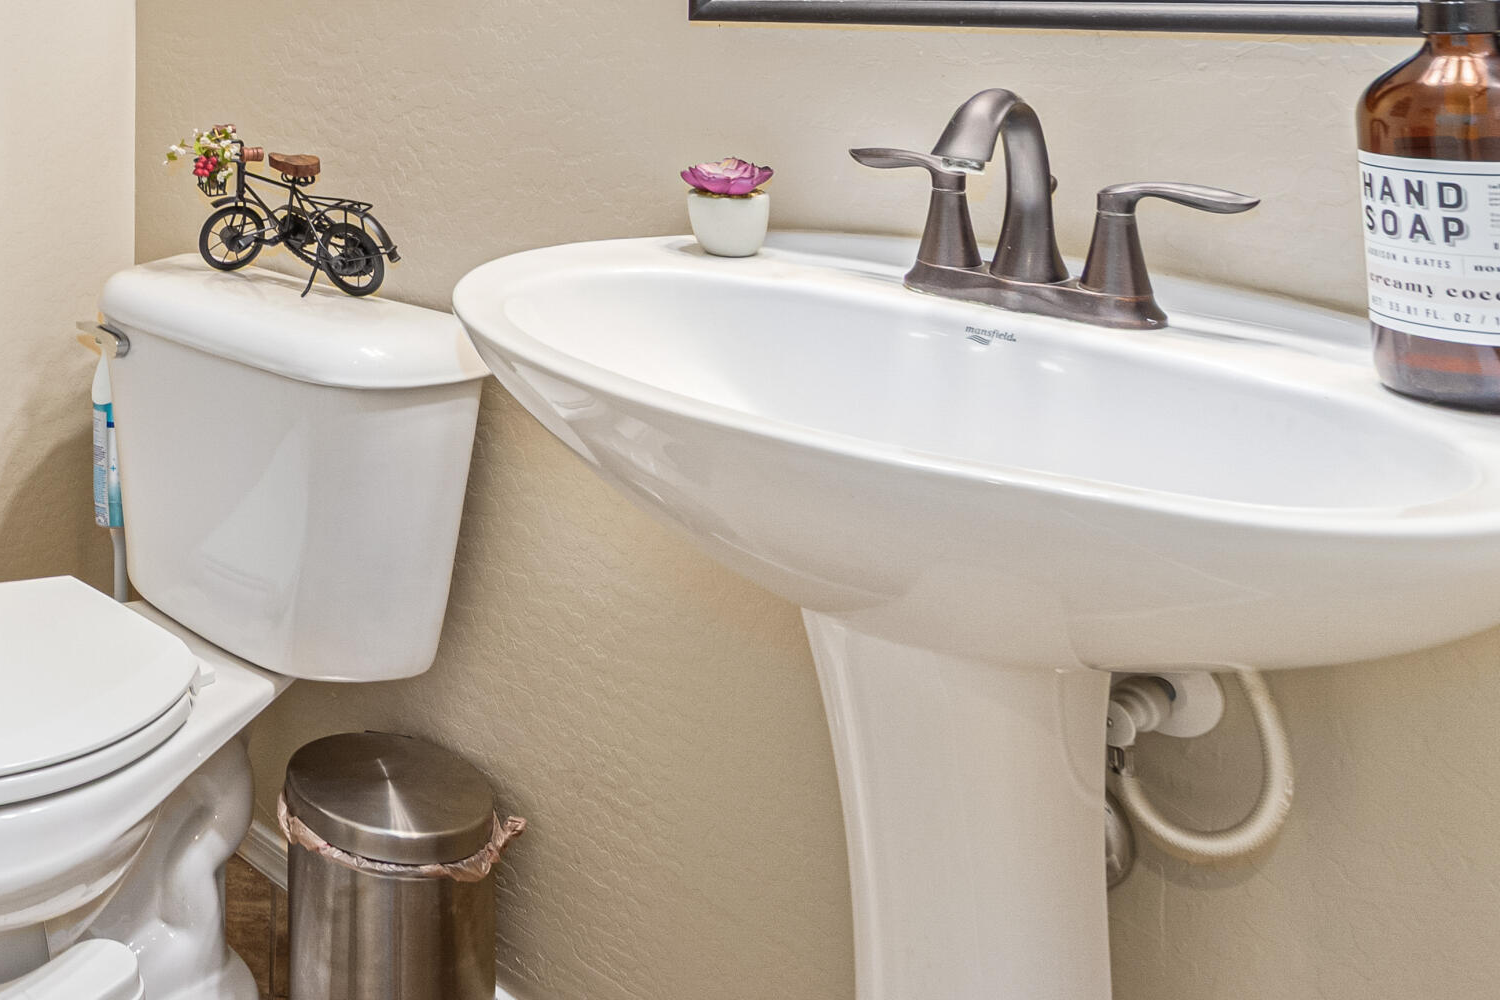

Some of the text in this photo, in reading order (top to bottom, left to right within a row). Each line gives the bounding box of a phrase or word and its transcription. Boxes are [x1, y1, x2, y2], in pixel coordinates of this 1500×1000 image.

[1363, 171, 1465, 210] HAND
[1365, 204, 1467, 245] SOAP
[1369, 272, 1434, 298] creamy
[964, 325, 1015, 342] mansfield
